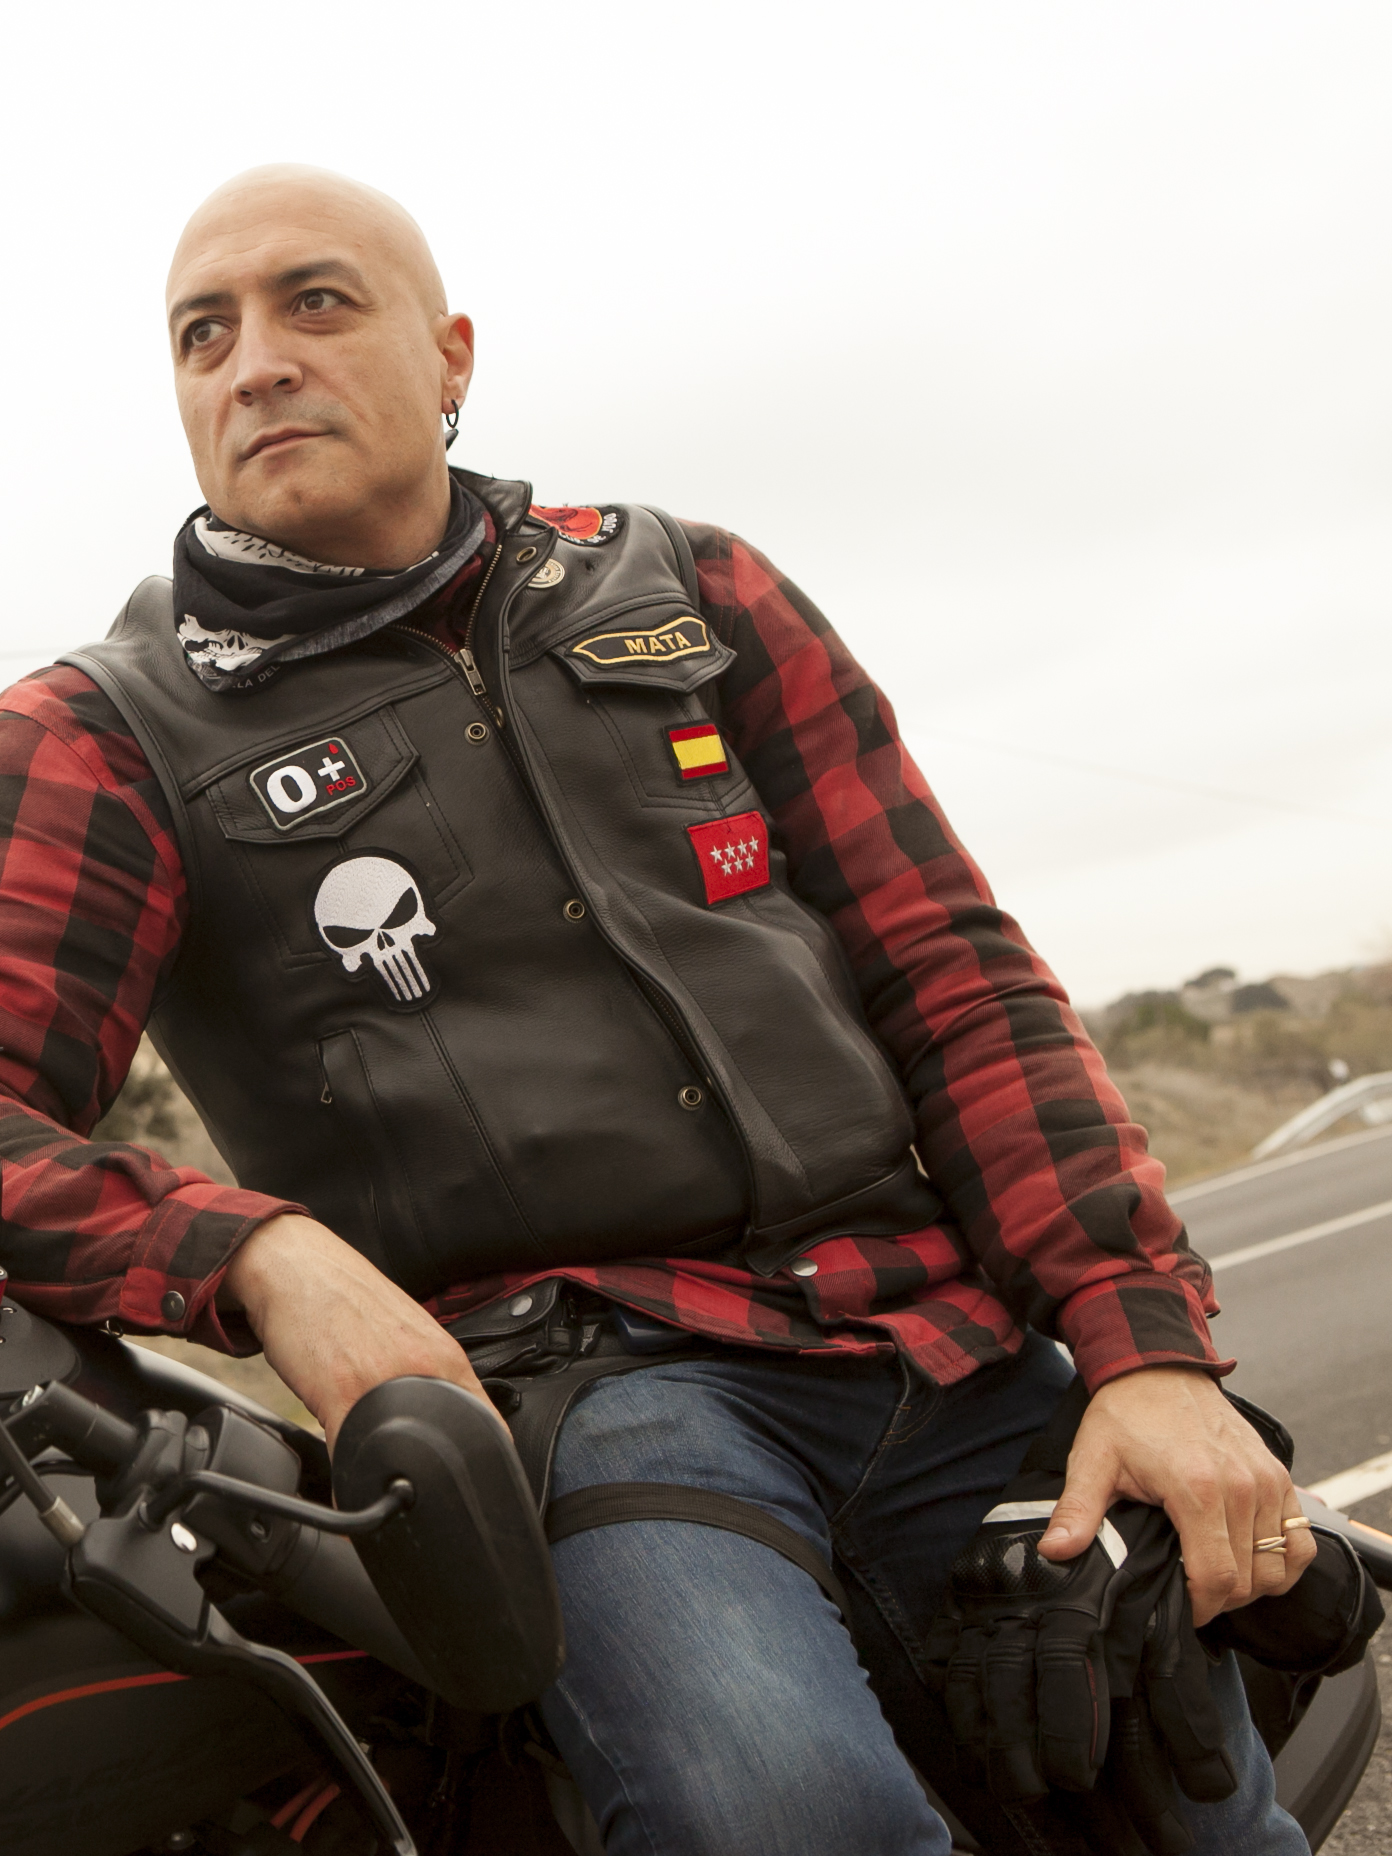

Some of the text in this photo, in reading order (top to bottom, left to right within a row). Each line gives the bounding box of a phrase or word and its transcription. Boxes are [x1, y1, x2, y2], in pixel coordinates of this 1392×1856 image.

[624, 631, 692, 654] MATA
[257, 664, 281, 682] DEL
[326, 775, 357, 796] POS
